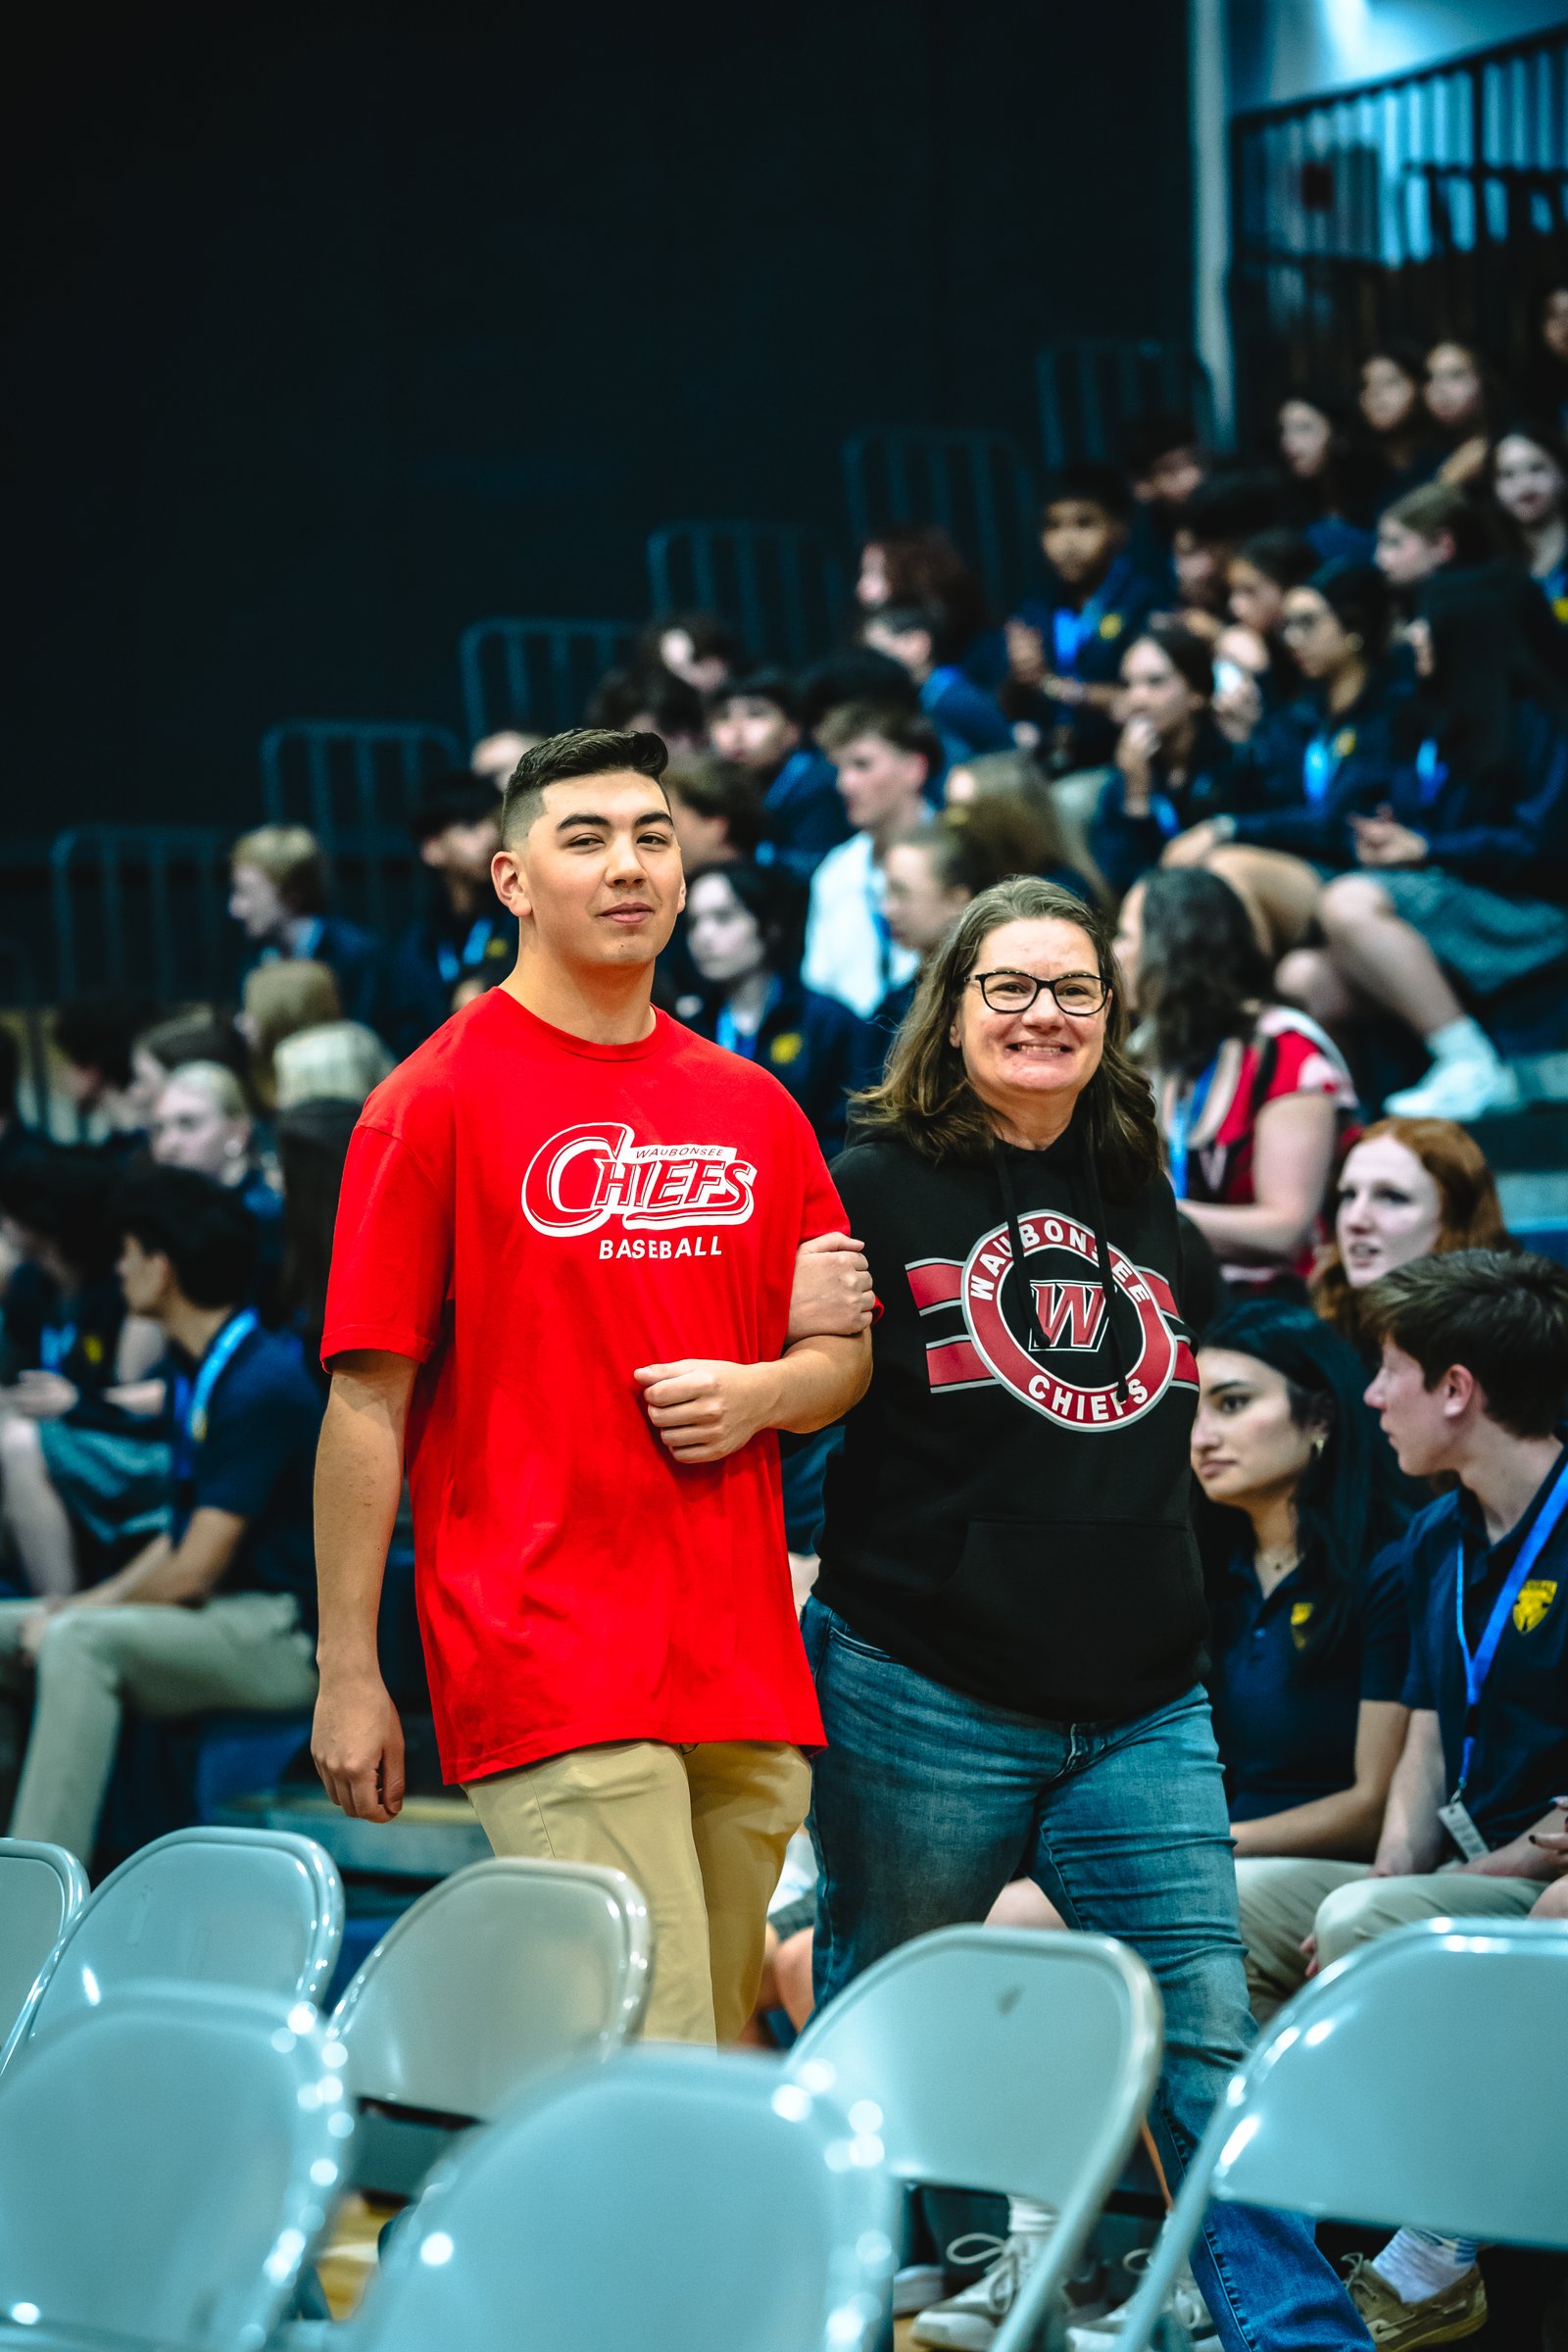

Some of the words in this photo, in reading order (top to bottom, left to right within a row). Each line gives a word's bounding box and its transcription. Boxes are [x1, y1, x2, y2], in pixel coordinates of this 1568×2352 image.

[522, 1122, 758, 1237] CHIEFS
[636, 1147, 723, 1159] WAUBONSEE
[599, 1236, 722, 1259] BASEBALL
[970, 1219, 1151, 1301] WAUBONEE
[1029, 1280, 1110, 1352] W
